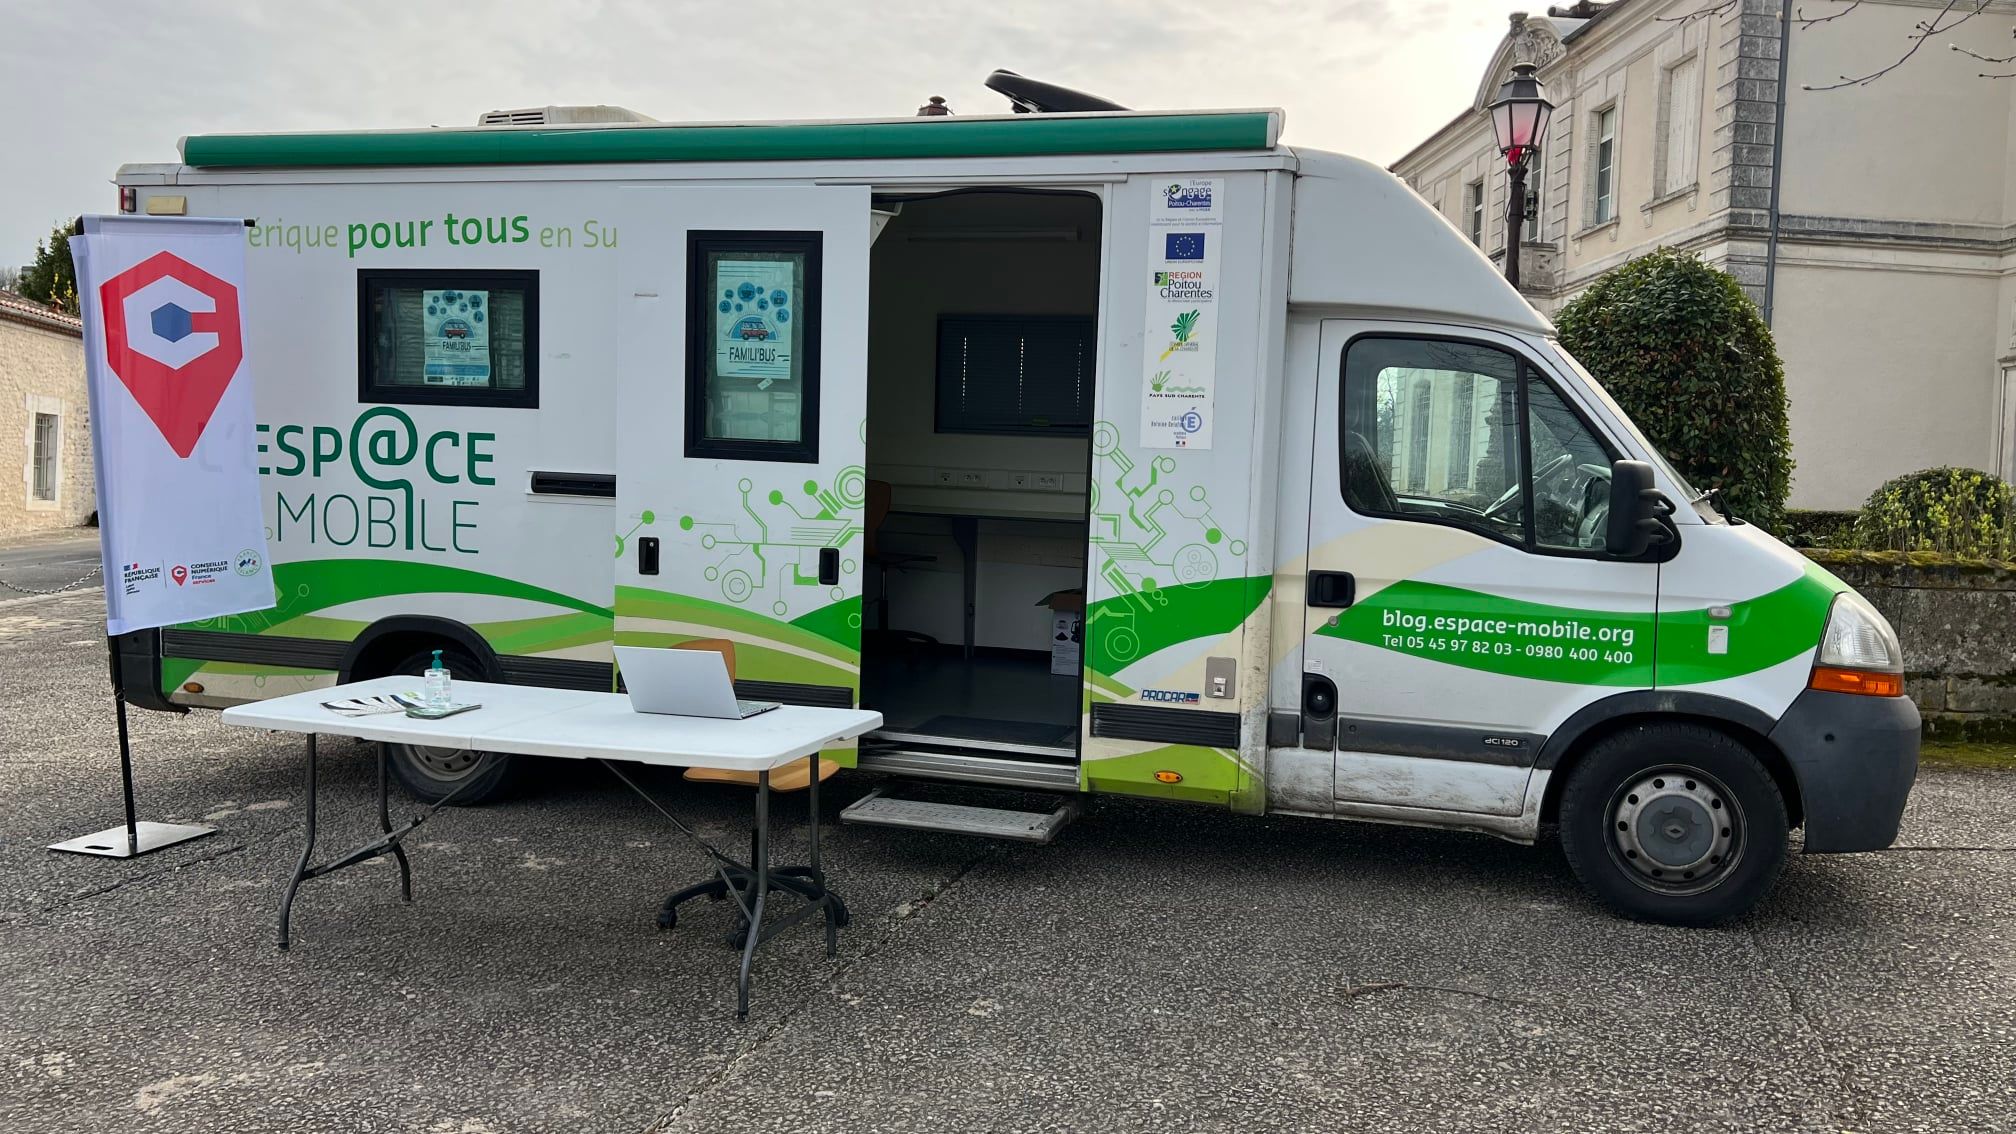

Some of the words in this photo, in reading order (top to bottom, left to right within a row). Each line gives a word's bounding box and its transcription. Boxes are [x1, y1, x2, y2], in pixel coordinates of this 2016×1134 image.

[248, 217, 339, 254] érique
[347, 220, 433, 258] pour
[444, 213, 530, 246] tous
[540, 226, 572, 248] en
[583, 219, 617, 248] Su
[1168, 271, 1202, 279] REGION
[1168, 278, 1201, 290] Poitou
[1160, 287, 1212, 299] Charentes
[729, 346, 776, 362] FAMILI'BUS
[277, 484, 479, 554] MOBILE
[190, 560, 228, 569] CONSEILLER
[191, 566, 228, 575] NUMÉRIQUE
[124, 567, 161, 579] RÉPUBLIQUE
[124, 573, 159, 584] FRANÇAISE
[1382, 609, 1634, 647] blog.espace-mobile.org
[1382, 634, 1403, 648] Tel
[1406, 635, 1424, 649] 05
[1428, 637, 1446, 651] 45
[1450, 639, 1468, 652] 97
[1472, 641, 1490, 654] 82
[1494, 642, 1512, 655] 03
[1525, 644, 1564, 659] 0980
[1569, 647, 1598, 661] 400
[1604, 649, 1633, 664] 400
[1141, 689, 1186, 703] PROCAR
[1501, 738, 1519, 747] 120
